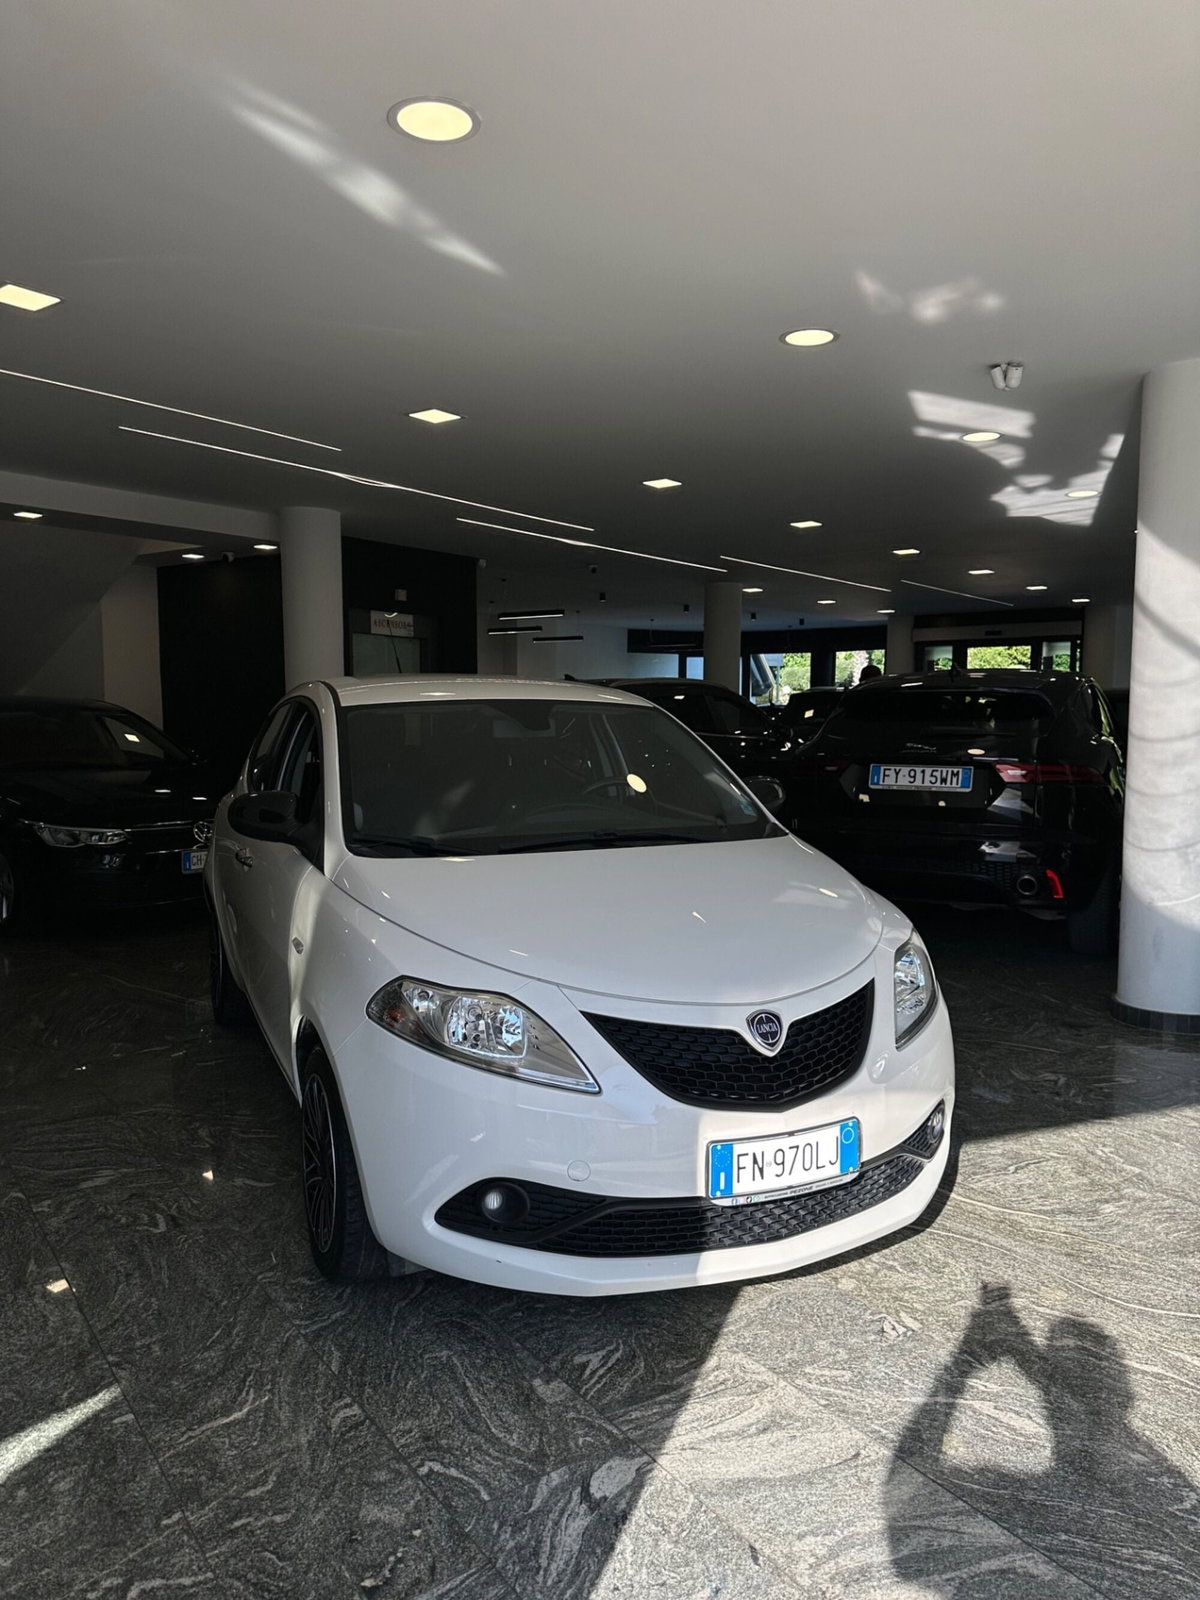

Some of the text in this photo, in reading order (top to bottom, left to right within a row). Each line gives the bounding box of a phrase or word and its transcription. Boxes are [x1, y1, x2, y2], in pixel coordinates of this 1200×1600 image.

[882, 768, 960, 785] FY 915WM
[737, 1136, 839, 1184] FN 970LJ
